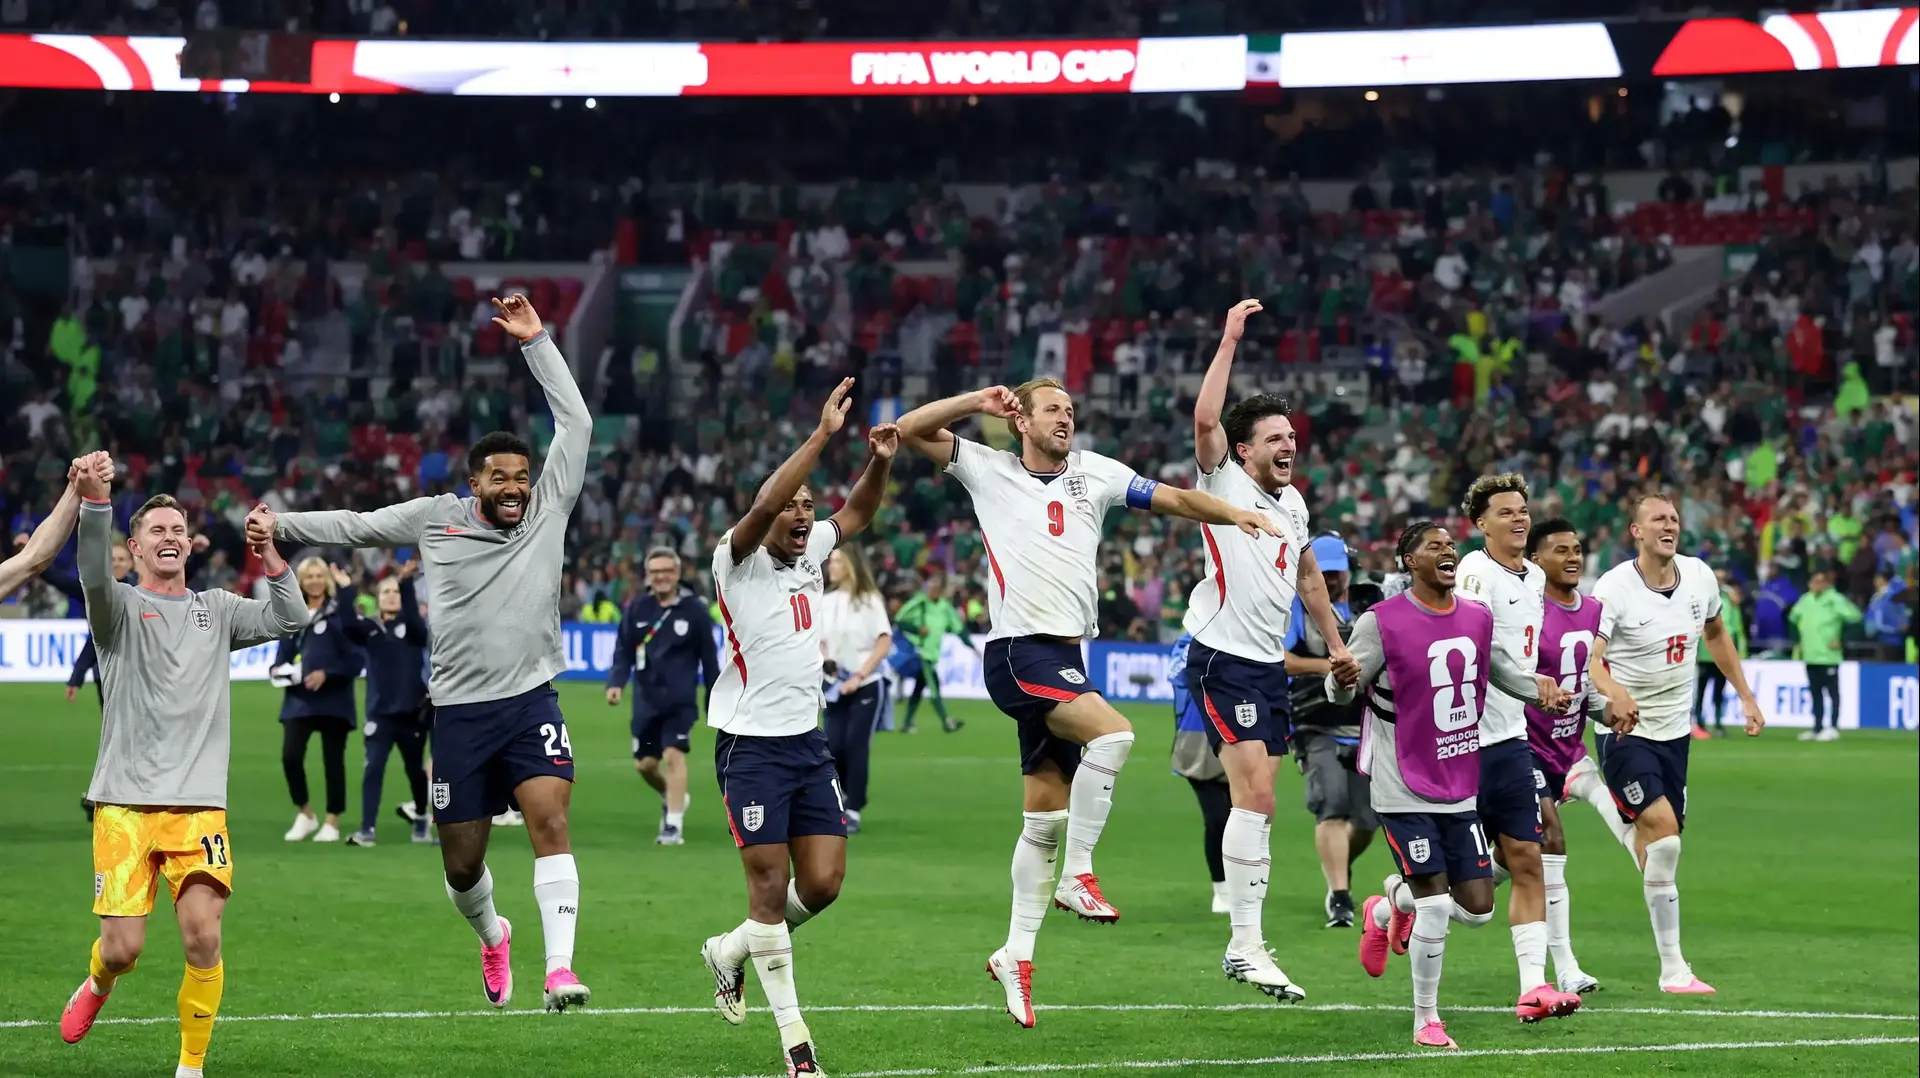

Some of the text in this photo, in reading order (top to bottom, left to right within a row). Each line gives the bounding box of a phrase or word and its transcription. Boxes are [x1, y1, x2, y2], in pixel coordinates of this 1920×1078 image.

[851, 49, 1136, 84] FIFA WORLD CUP
[1047, 501, 1064, 536] 9
[1275, 542, 1288, 576] 4
[790, 593, 812, 632] 10
[27, 633, 90, 668] UNI
[1524, 625, 1534, 657] 3
[1667, 635, 1687, 664] 15
[1776, 685, 1813, 715] FIF
[1450, 711, 1468, 723] FIFA
[540, 723, 573, 758] 24
[1436, 729, 1479, 746] WORLD CUP
[1437, 739, 1479, 760] 2026
[830, 778, 844, 812] 1
[200, 834, 227, 865] 13
[557, 905, 576, 915] ENG
